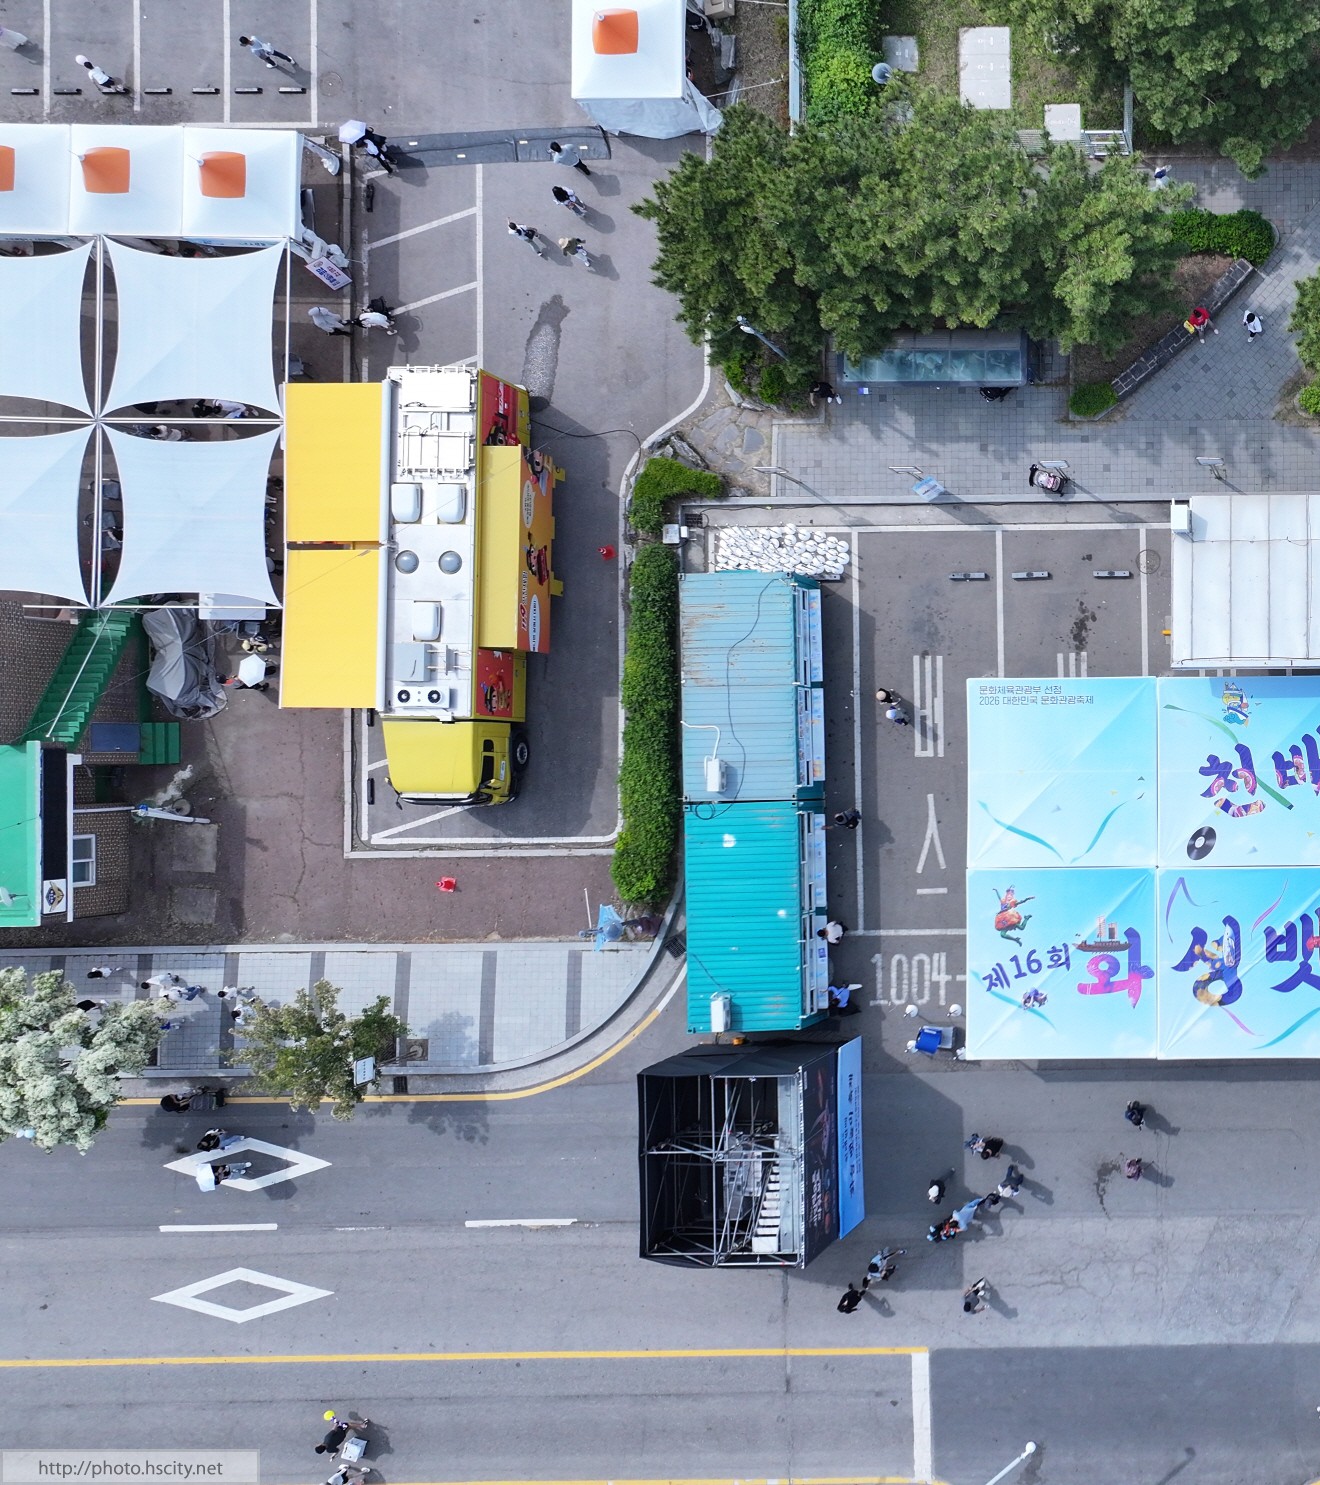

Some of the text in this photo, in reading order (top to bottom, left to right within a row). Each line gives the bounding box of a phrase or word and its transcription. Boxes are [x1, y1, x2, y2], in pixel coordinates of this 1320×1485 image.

[979, 685, 1062, 695] 문화체육관광부 선정
[979, 695, 1094, 706] 2026 대한민국 문화관광축제
[981, 942, 1072, 992] 제16회
